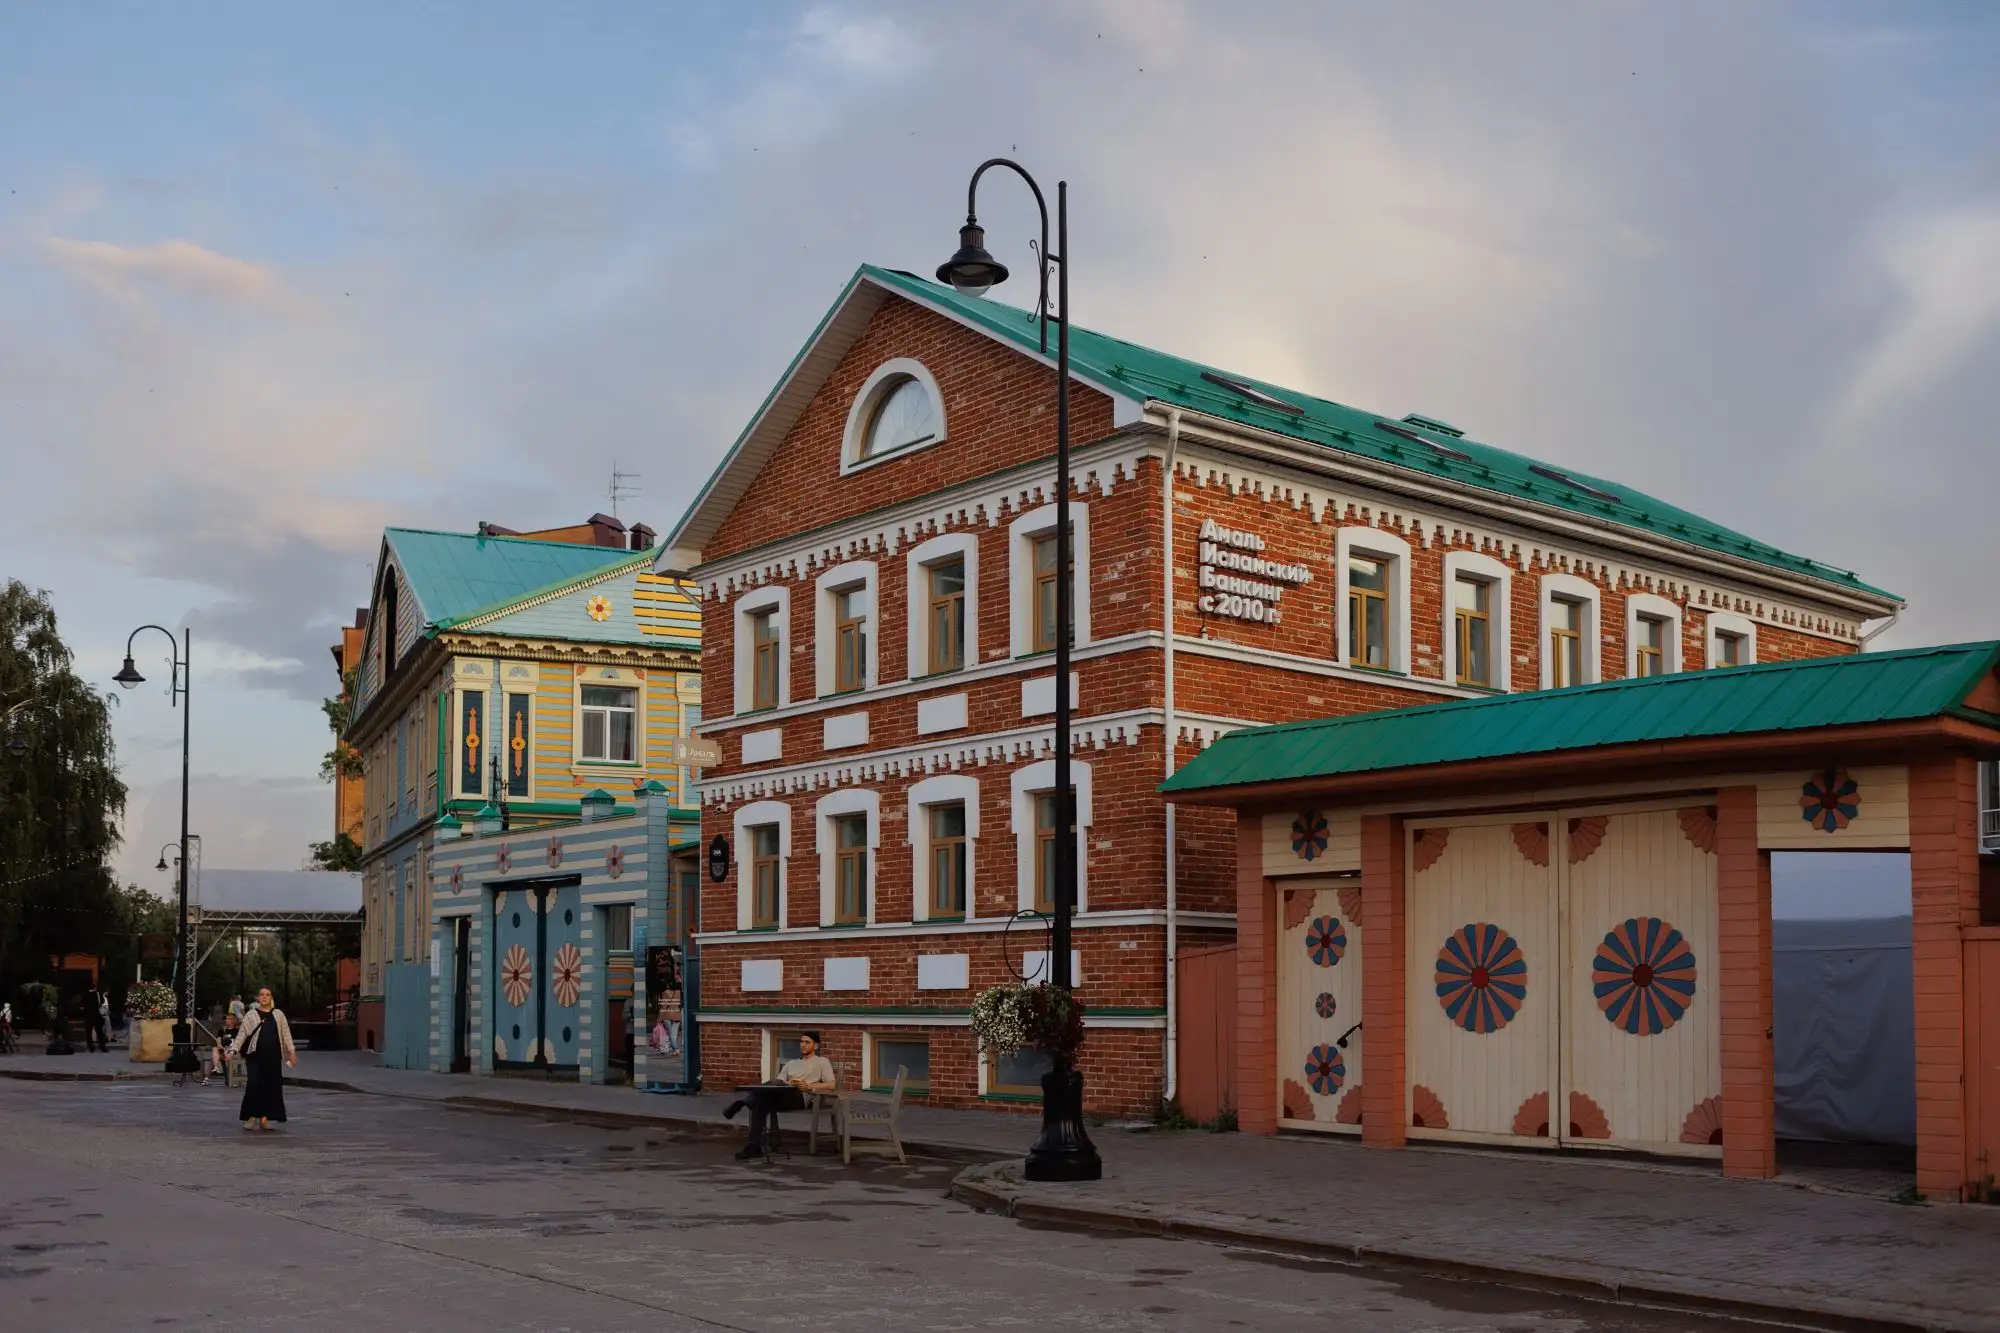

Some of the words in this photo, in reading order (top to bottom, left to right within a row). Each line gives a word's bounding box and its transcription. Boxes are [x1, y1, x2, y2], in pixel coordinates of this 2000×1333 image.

[1199, 518, 1265, 550] Амаль
[1200, 542, 1313, 584] Исламский
[1200, 565, 1283, 601] Банкинг
